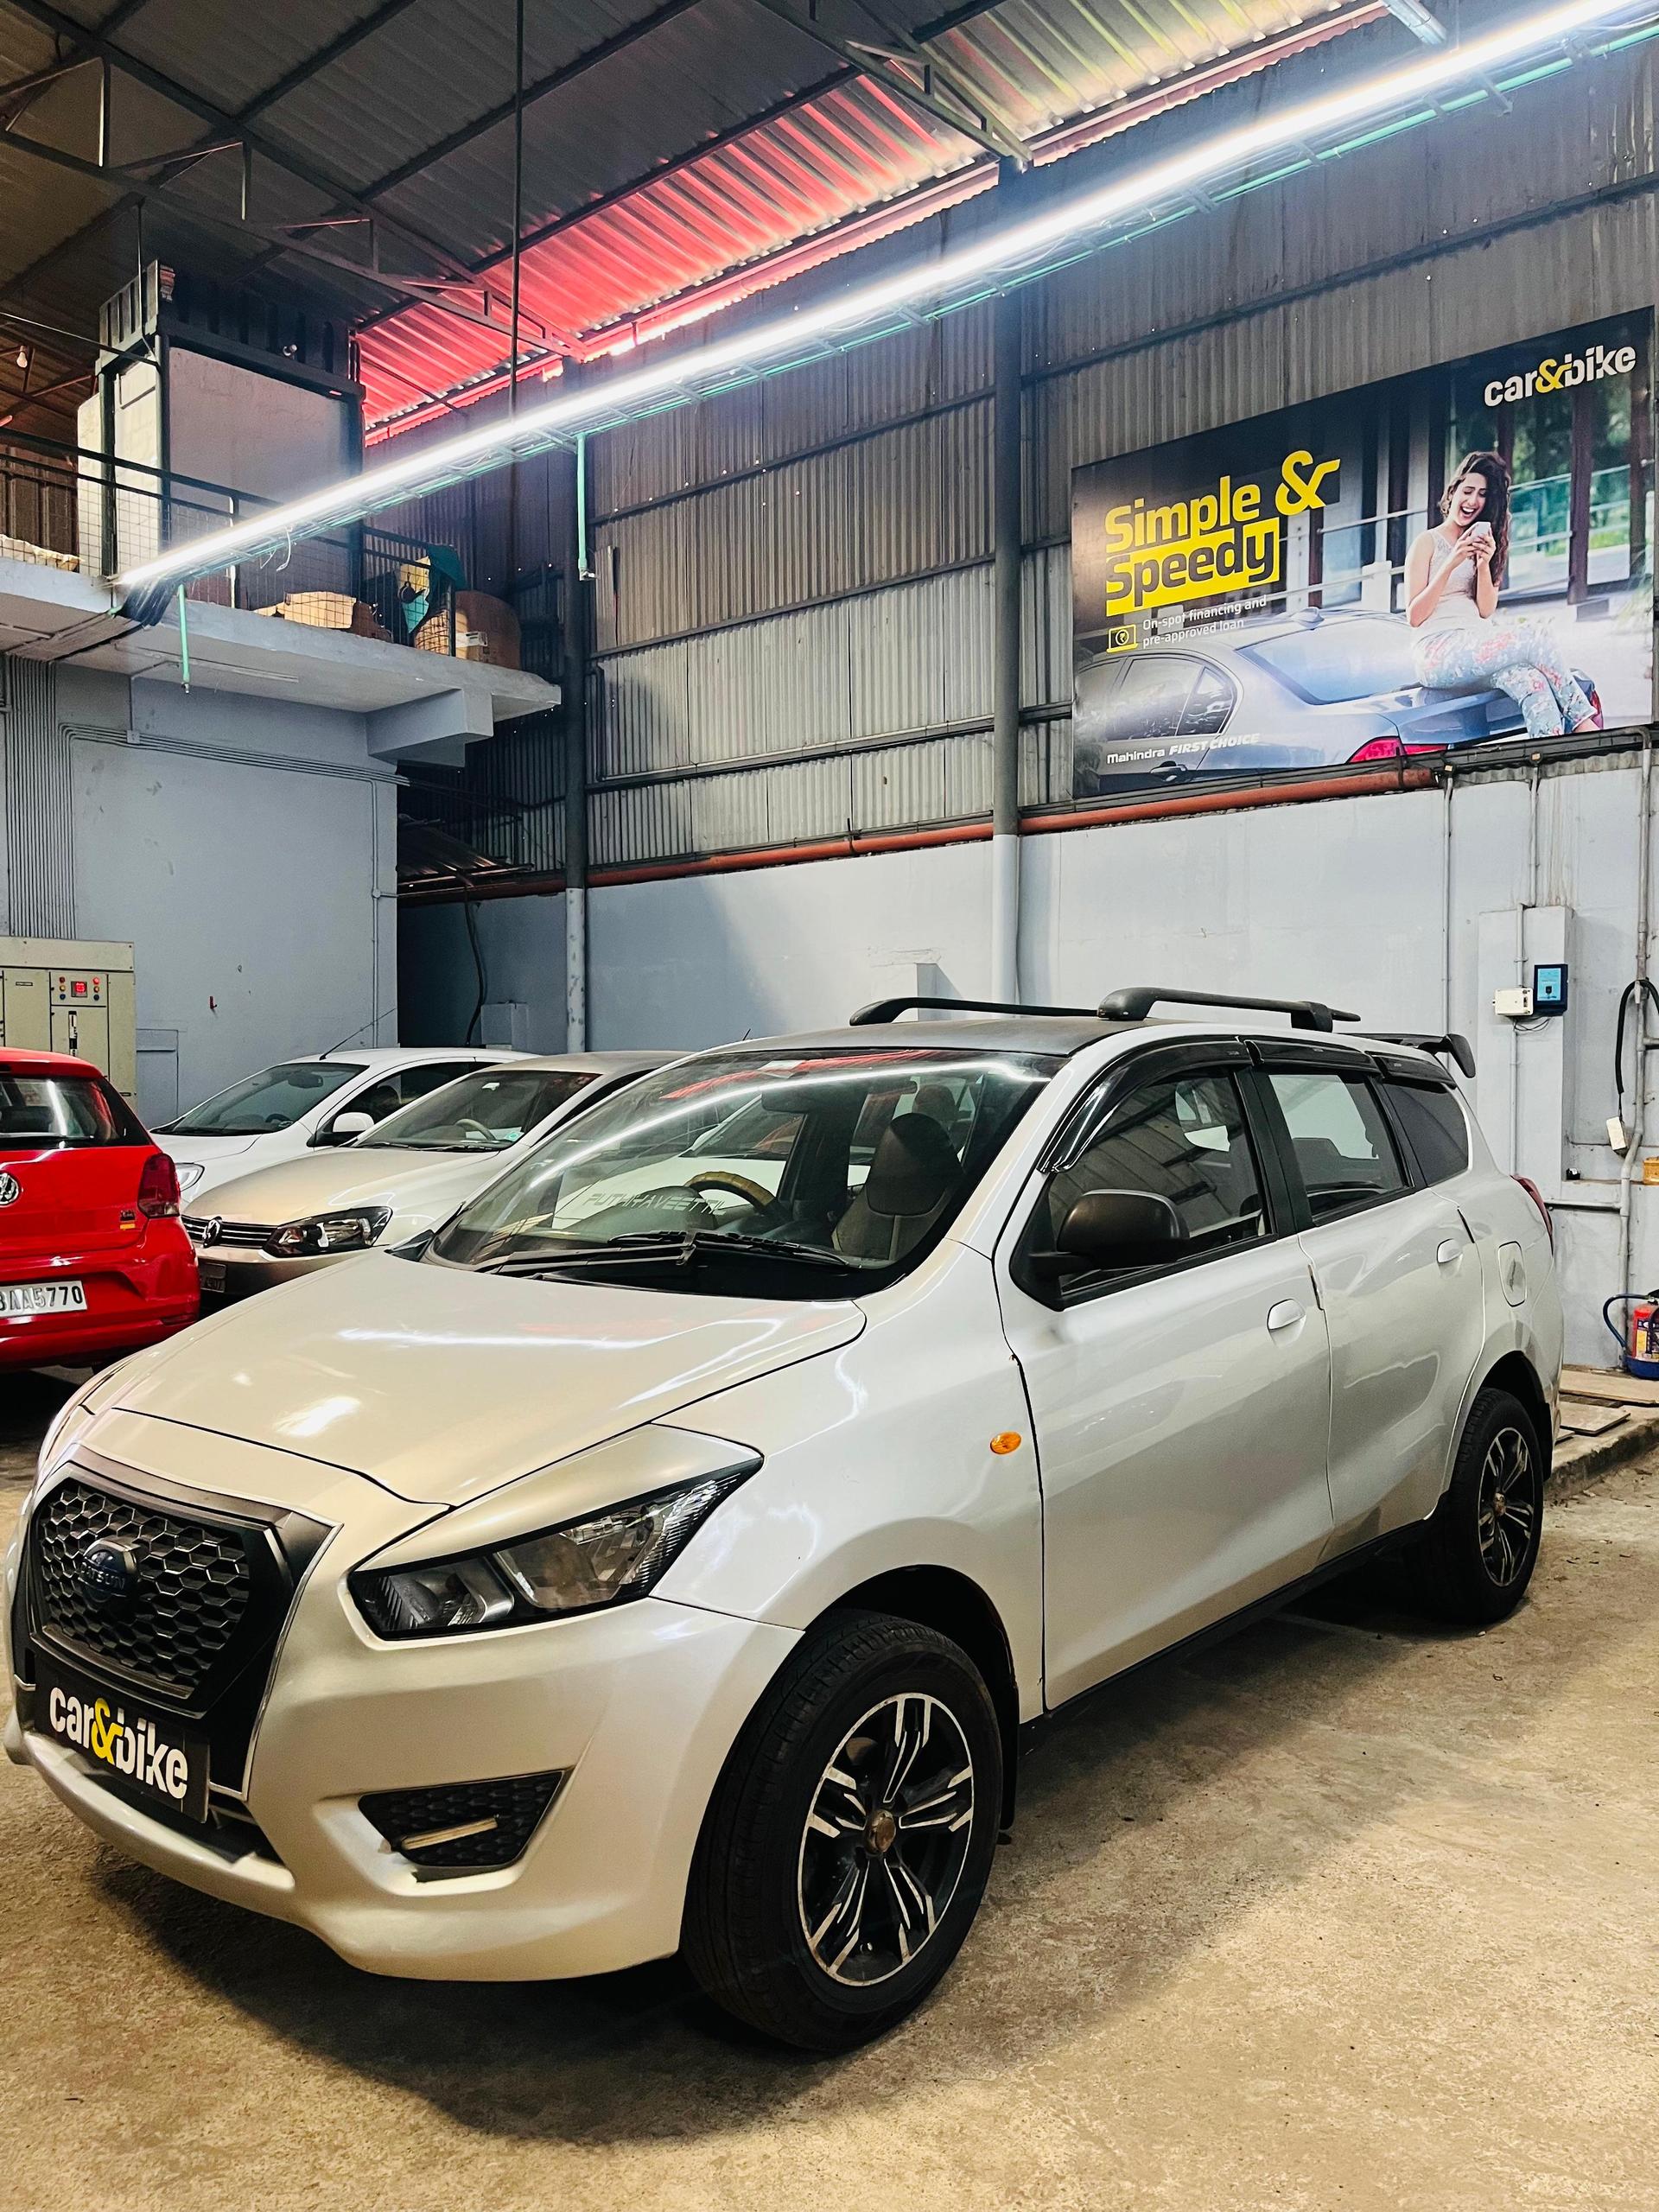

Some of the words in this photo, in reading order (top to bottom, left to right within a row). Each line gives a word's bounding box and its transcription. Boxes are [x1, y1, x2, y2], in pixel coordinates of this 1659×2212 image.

[1484, 346, 1637, 407] car&bike
[1104, 475, 1262, 554] Simple
[1274, 449, 1341, 516] &
[1105, 525, 1274, 607] Speedy
[1142, 611, 1186, 631] On-spot
[1189, 604, 1242, 622] financing
[1244, 594, 1267, 608] and
[1142, 626, 1217, 650] pre-approved
[1219, 619, 1244, 632] loan
[1107, 748, 1166, 765] Mahindra
[1168, 741, 1210, 756] FIRST
[1210, 734, 1260, 750] CHOICE
[49, 1687, 188, 1799] car&bike
